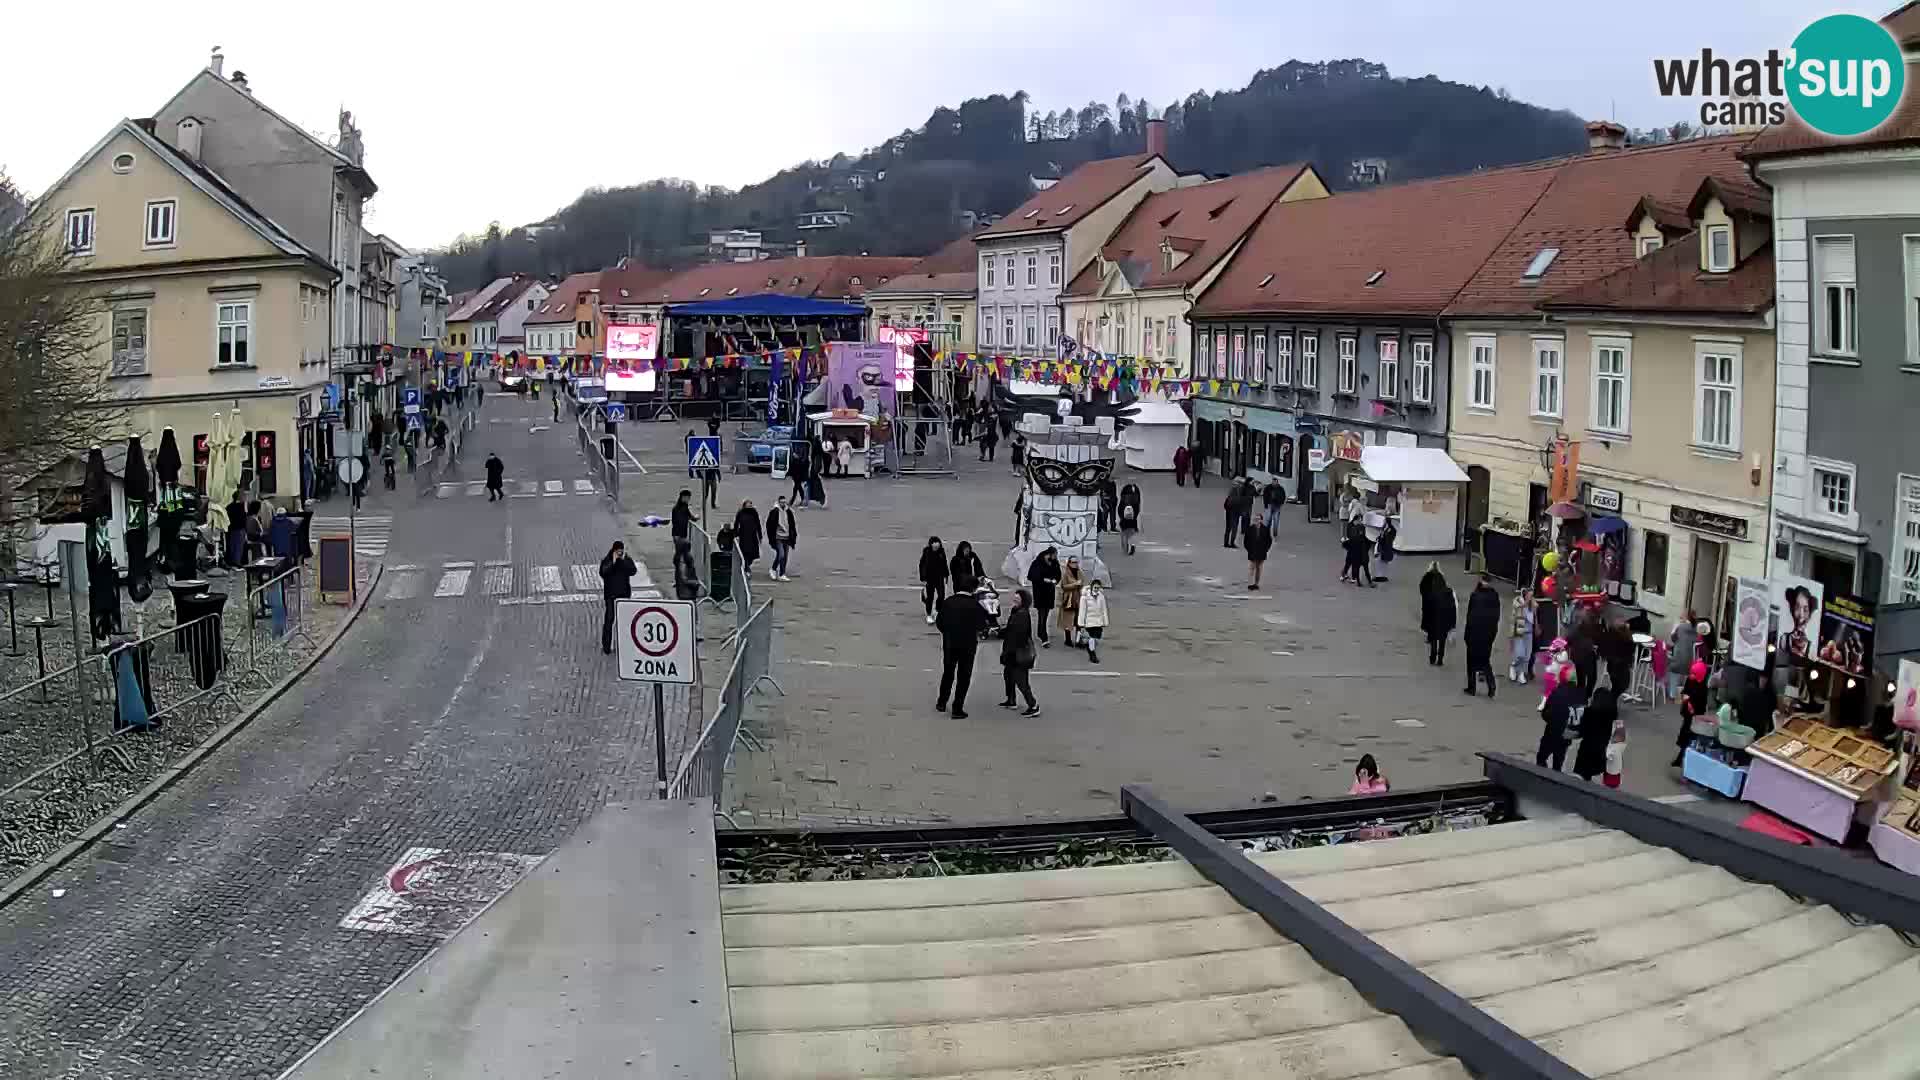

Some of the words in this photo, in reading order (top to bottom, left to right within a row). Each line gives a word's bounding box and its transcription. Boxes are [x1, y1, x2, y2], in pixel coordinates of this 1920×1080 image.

[1048, 516, 1087, 545] 200
[643, 622, 667, 643] 30
[633, 659, 678, 677] ZONA
